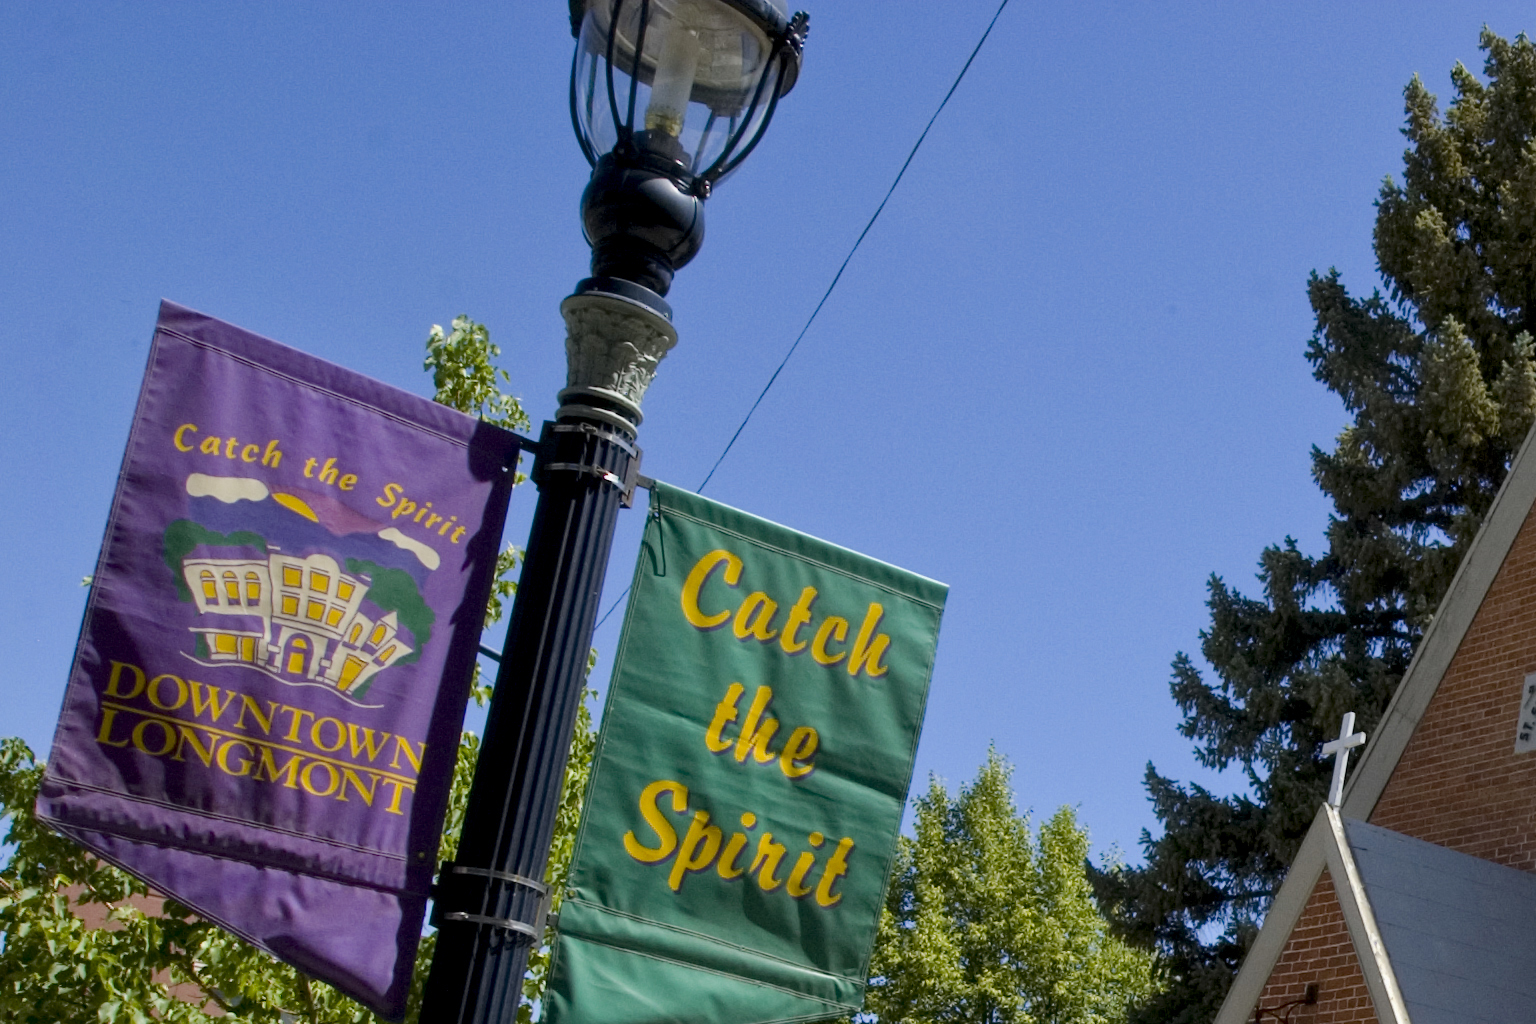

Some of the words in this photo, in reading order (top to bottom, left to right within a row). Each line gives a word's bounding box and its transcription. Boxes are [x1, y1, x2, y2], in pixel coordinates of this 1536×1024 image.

[174, 423, 283, 468] Catch
[304, 458, 358, 493] the
[376, 483, 468, 545] Spirit
[680, 549, 892, 678] Catch
[95, 707, 416, 815] LONGMONT
[103, 660, 427, 774] DOWNTOWN
[704, 682, 819, 779] the
[622, 780, 857, 908] Spirit
